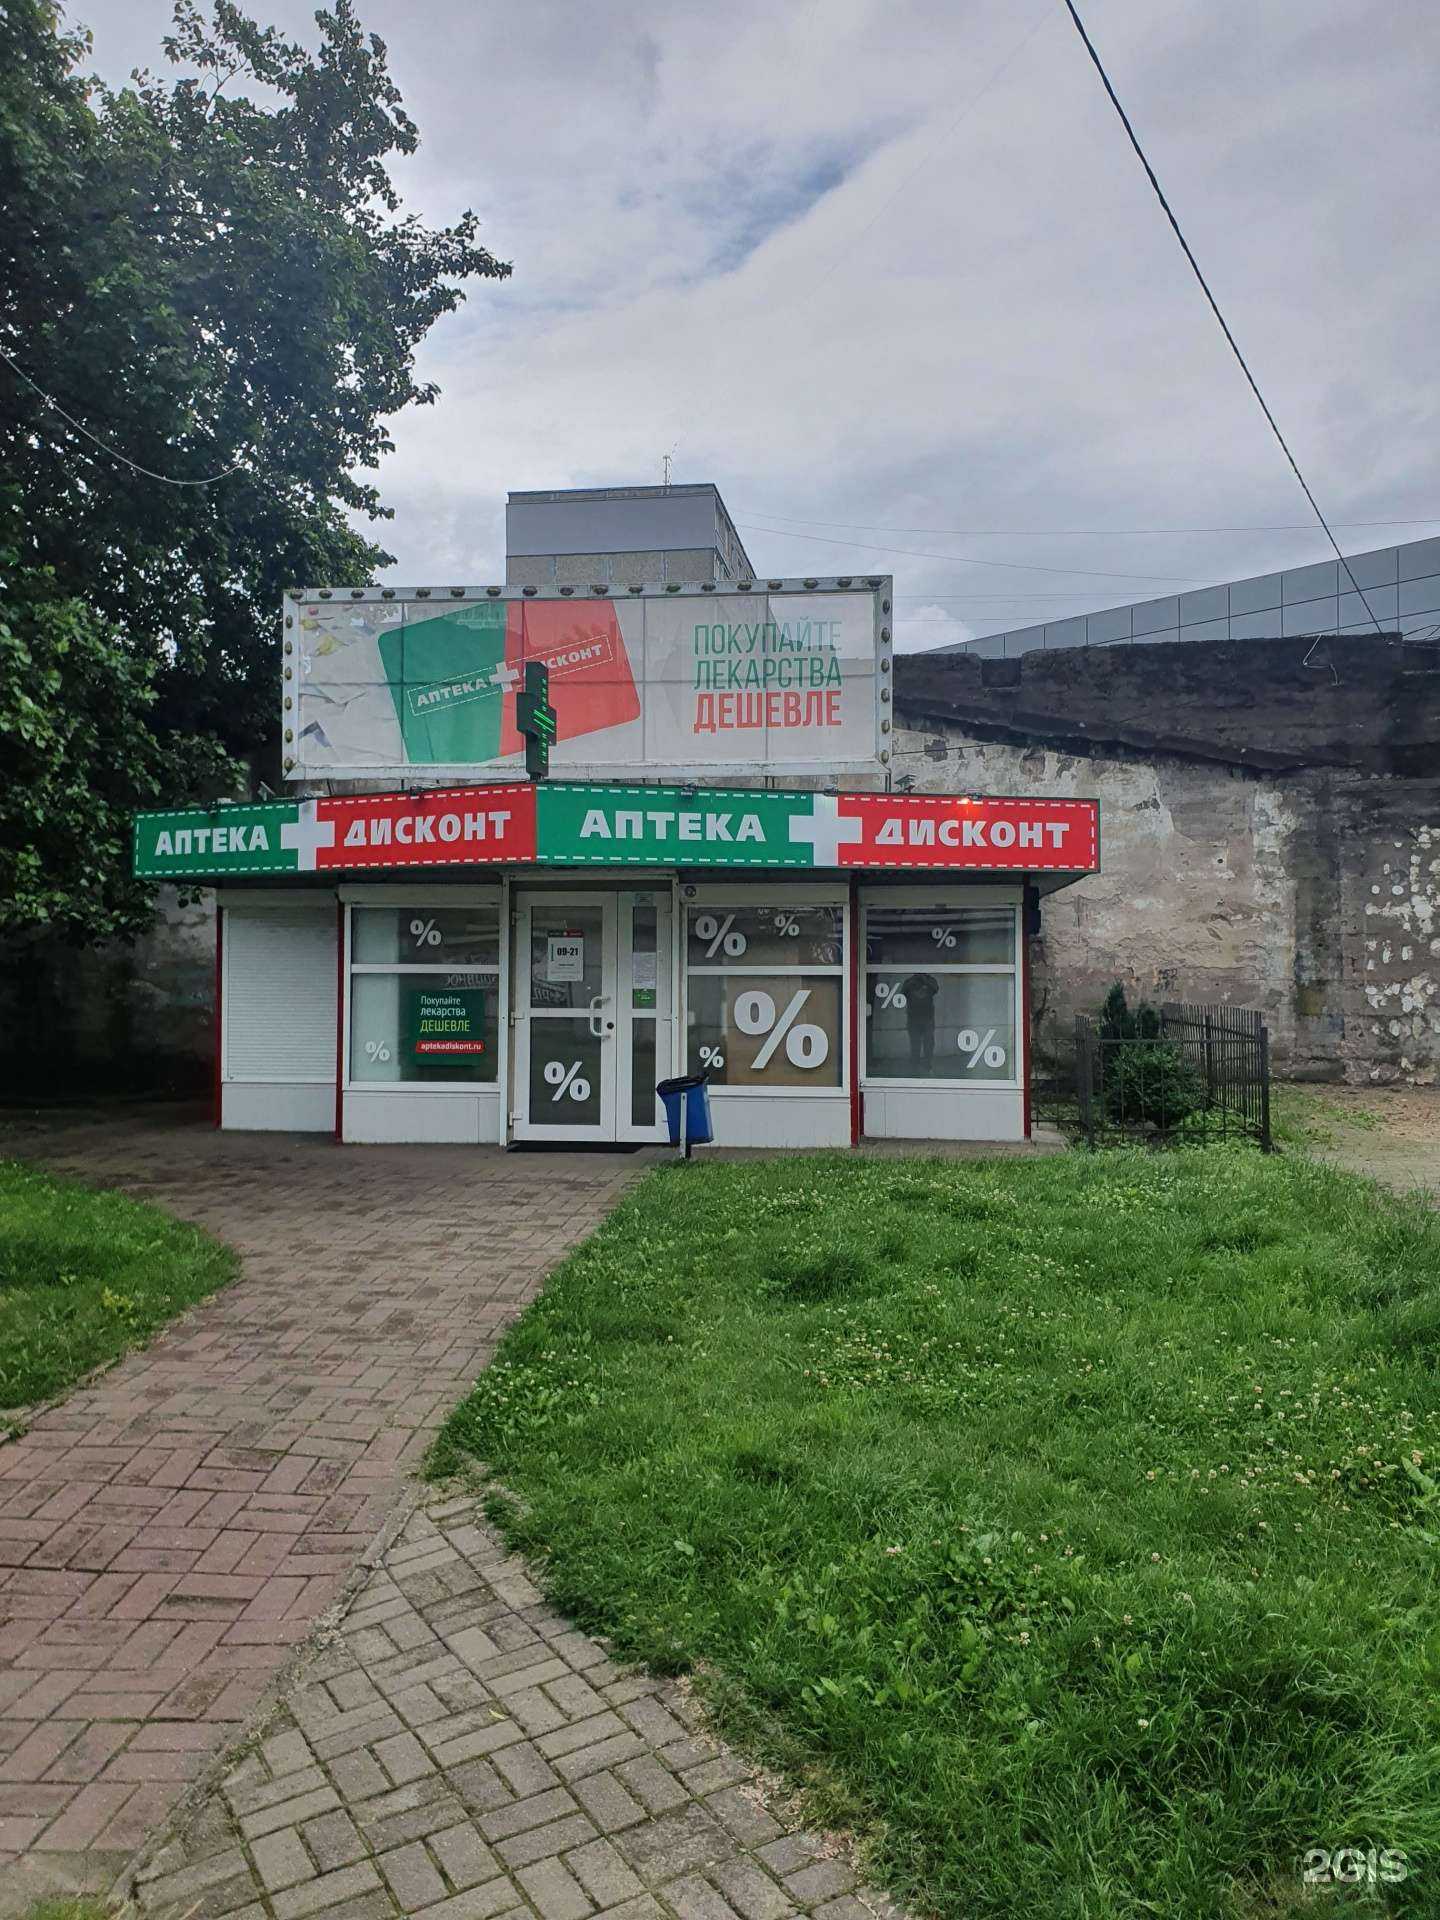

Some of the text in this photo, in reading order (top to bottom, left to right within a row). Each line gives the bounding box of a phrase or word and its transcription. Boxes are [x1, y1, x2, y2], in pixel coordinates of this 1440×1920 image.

[694, 616, 842, 655] ПОКУПАЙТЕ
[417, 643, 602, 707] АПТЕКА СКОНТ
[694, 657, 842, 690] ЛЕКАРСТВА
[693, 691, 842, 733] ДЕШЕВЛЕ
[154, 810, 512, 856] АПТЕКА ДИСКОНТ
[579, 809, 1070, 849] АПТЕКА ДИСКОНТ
[420, 995, 461, 1007] Покупайте
[420, 1007, 466, 1018] лекарства
[420, 1020, 471, 1033] ДЕШЕВЛЕ
[421, 1042, 481, 1051] aptekadiskont.ru
